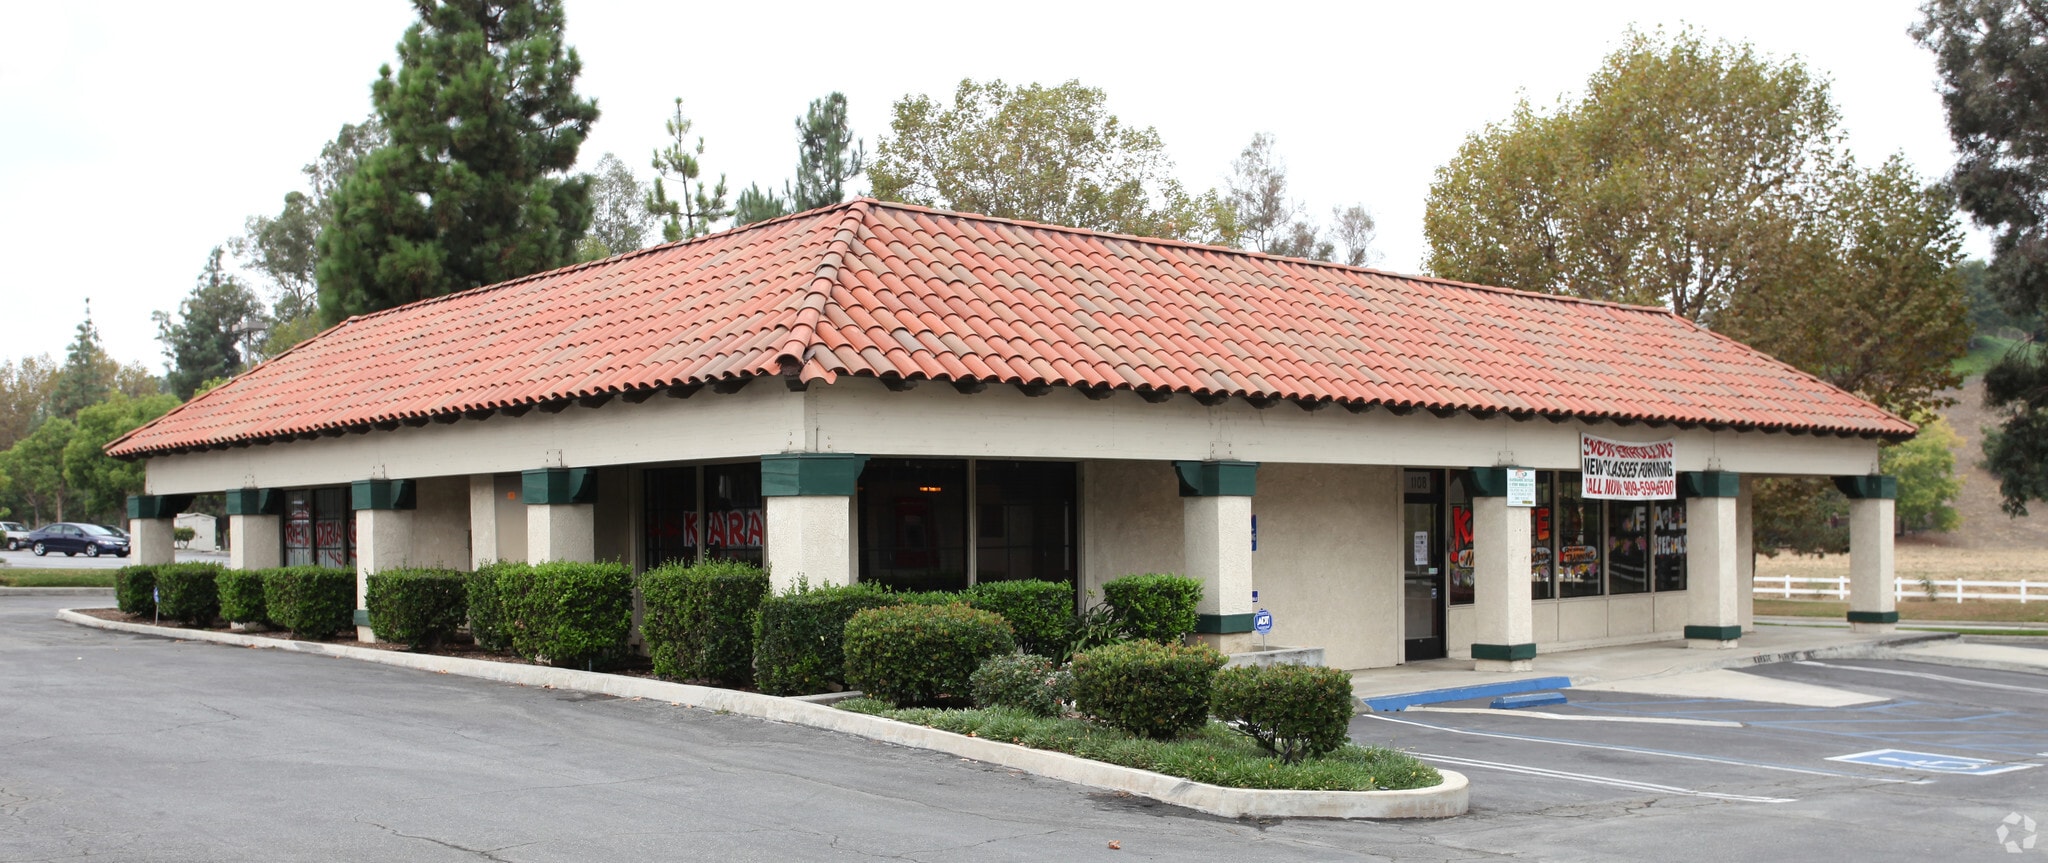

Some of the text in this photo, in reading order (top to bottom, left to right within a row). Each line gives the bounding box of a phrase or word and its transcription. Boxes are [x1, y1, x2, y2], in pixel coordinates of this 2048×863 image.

[1616, 442, 1673, 459] ENROLLING
[1584, 458, 1673, 478] NEW CLASSES FORMING
[1586, 478, 1602, 495] CALL
[1257, 615, 1270, 626] ADT
